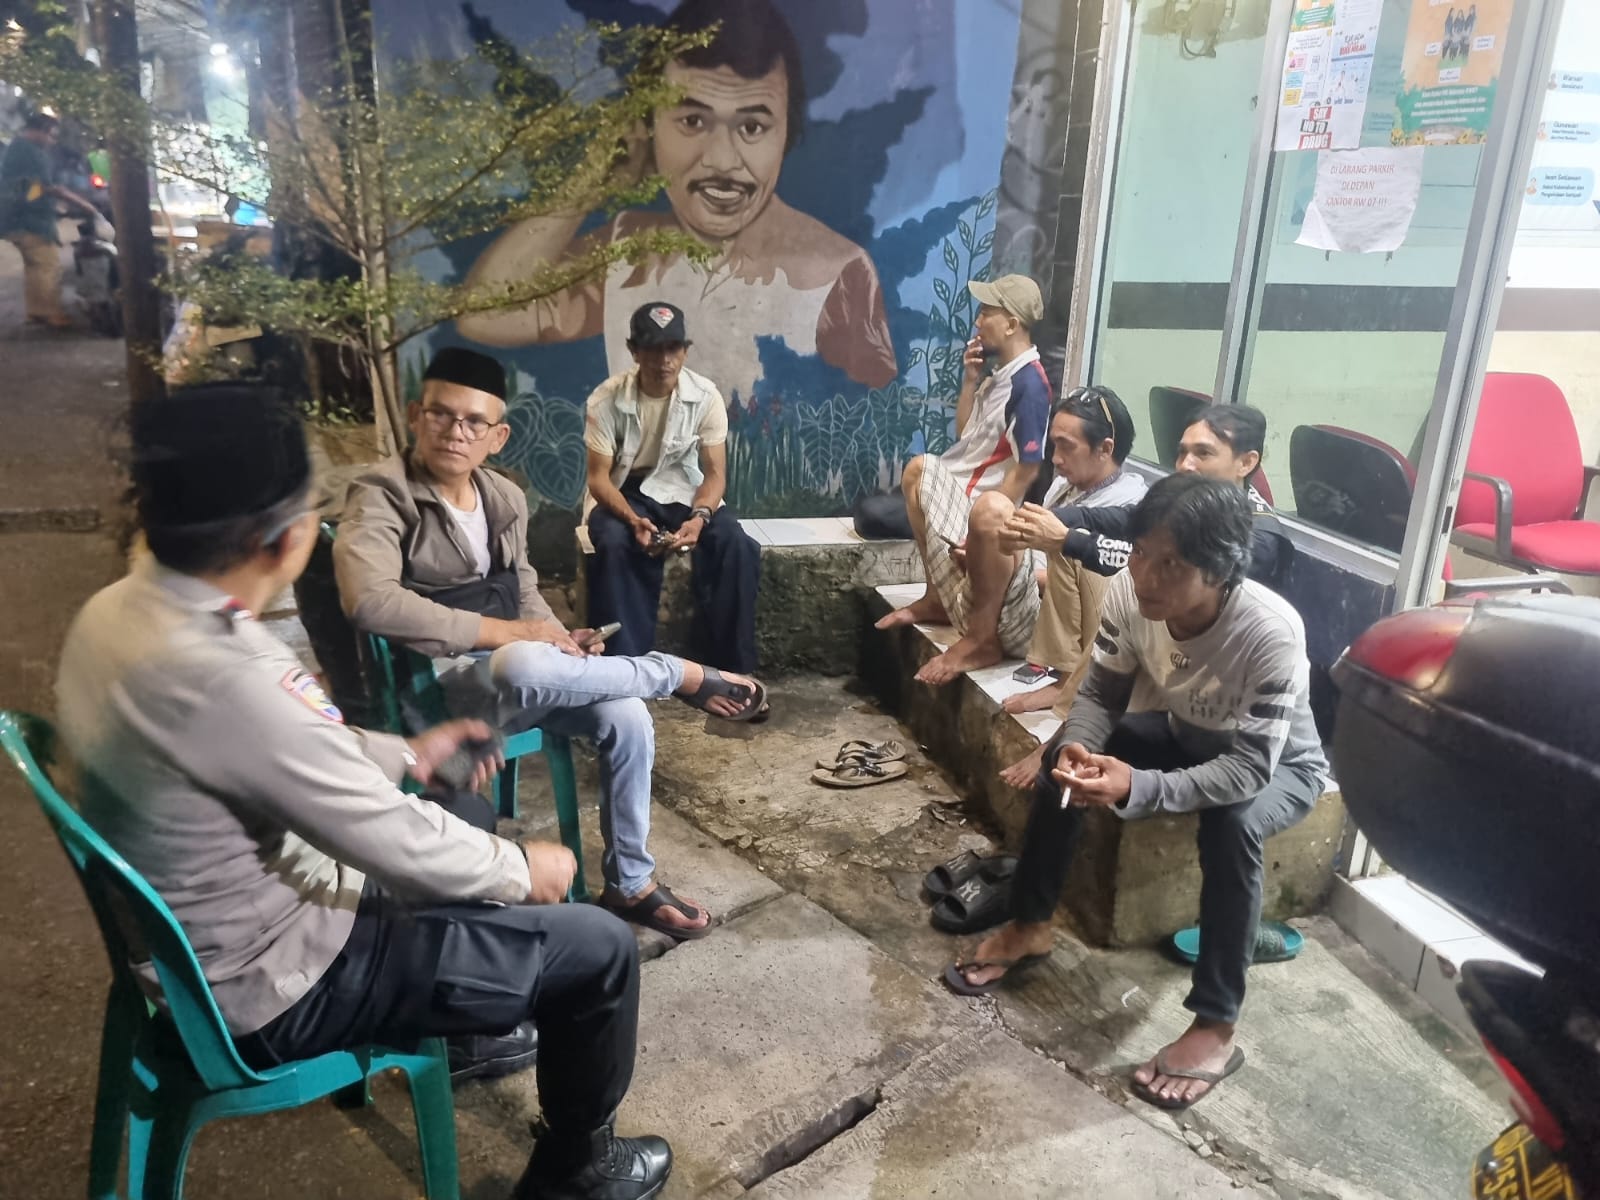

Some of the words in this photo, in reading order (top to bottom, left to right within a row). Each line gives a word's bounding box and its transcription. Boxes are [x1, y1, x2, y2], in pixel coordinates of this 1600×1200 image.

[1312, 107, 1329, 120] SAY
[1302, 120, 1315, 133] NO
[1302, 134, 1330, 149] DRUG
[1097, 548, 1130, 568] RID
